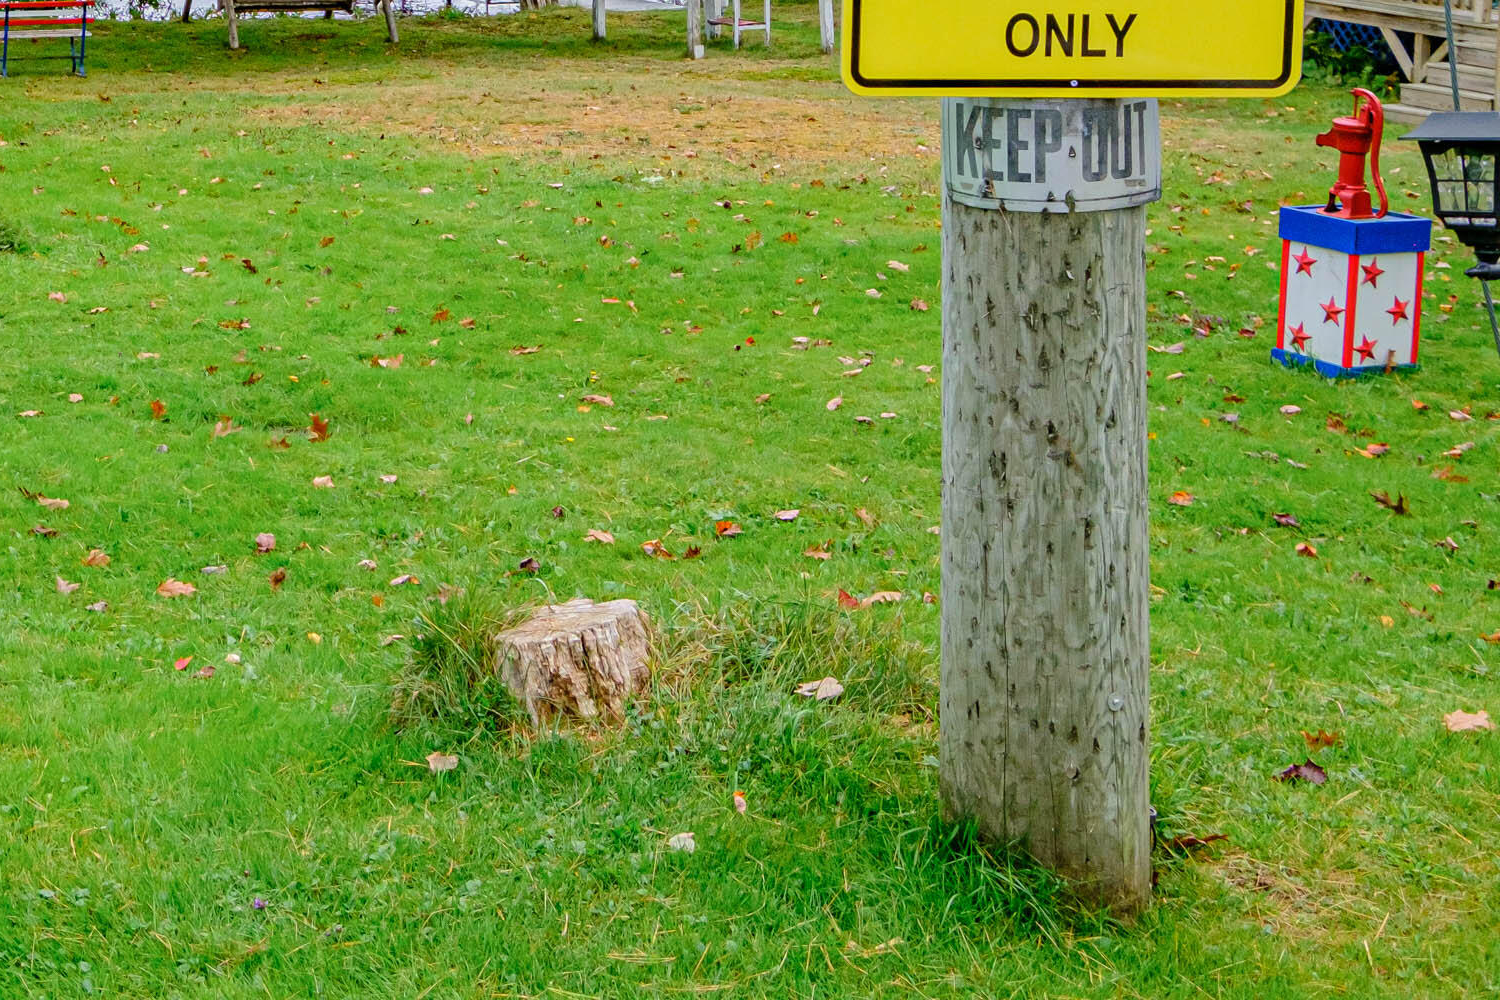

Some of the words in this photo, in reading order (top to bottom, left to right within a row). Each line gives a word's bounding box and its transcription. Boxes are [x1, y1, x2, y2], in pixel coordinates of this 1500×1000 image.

[1005, 12, 1137, 58] ONLY
[956, 102, 1062, 184] KEEP
[1082, 101, 1147, 182] OUT
